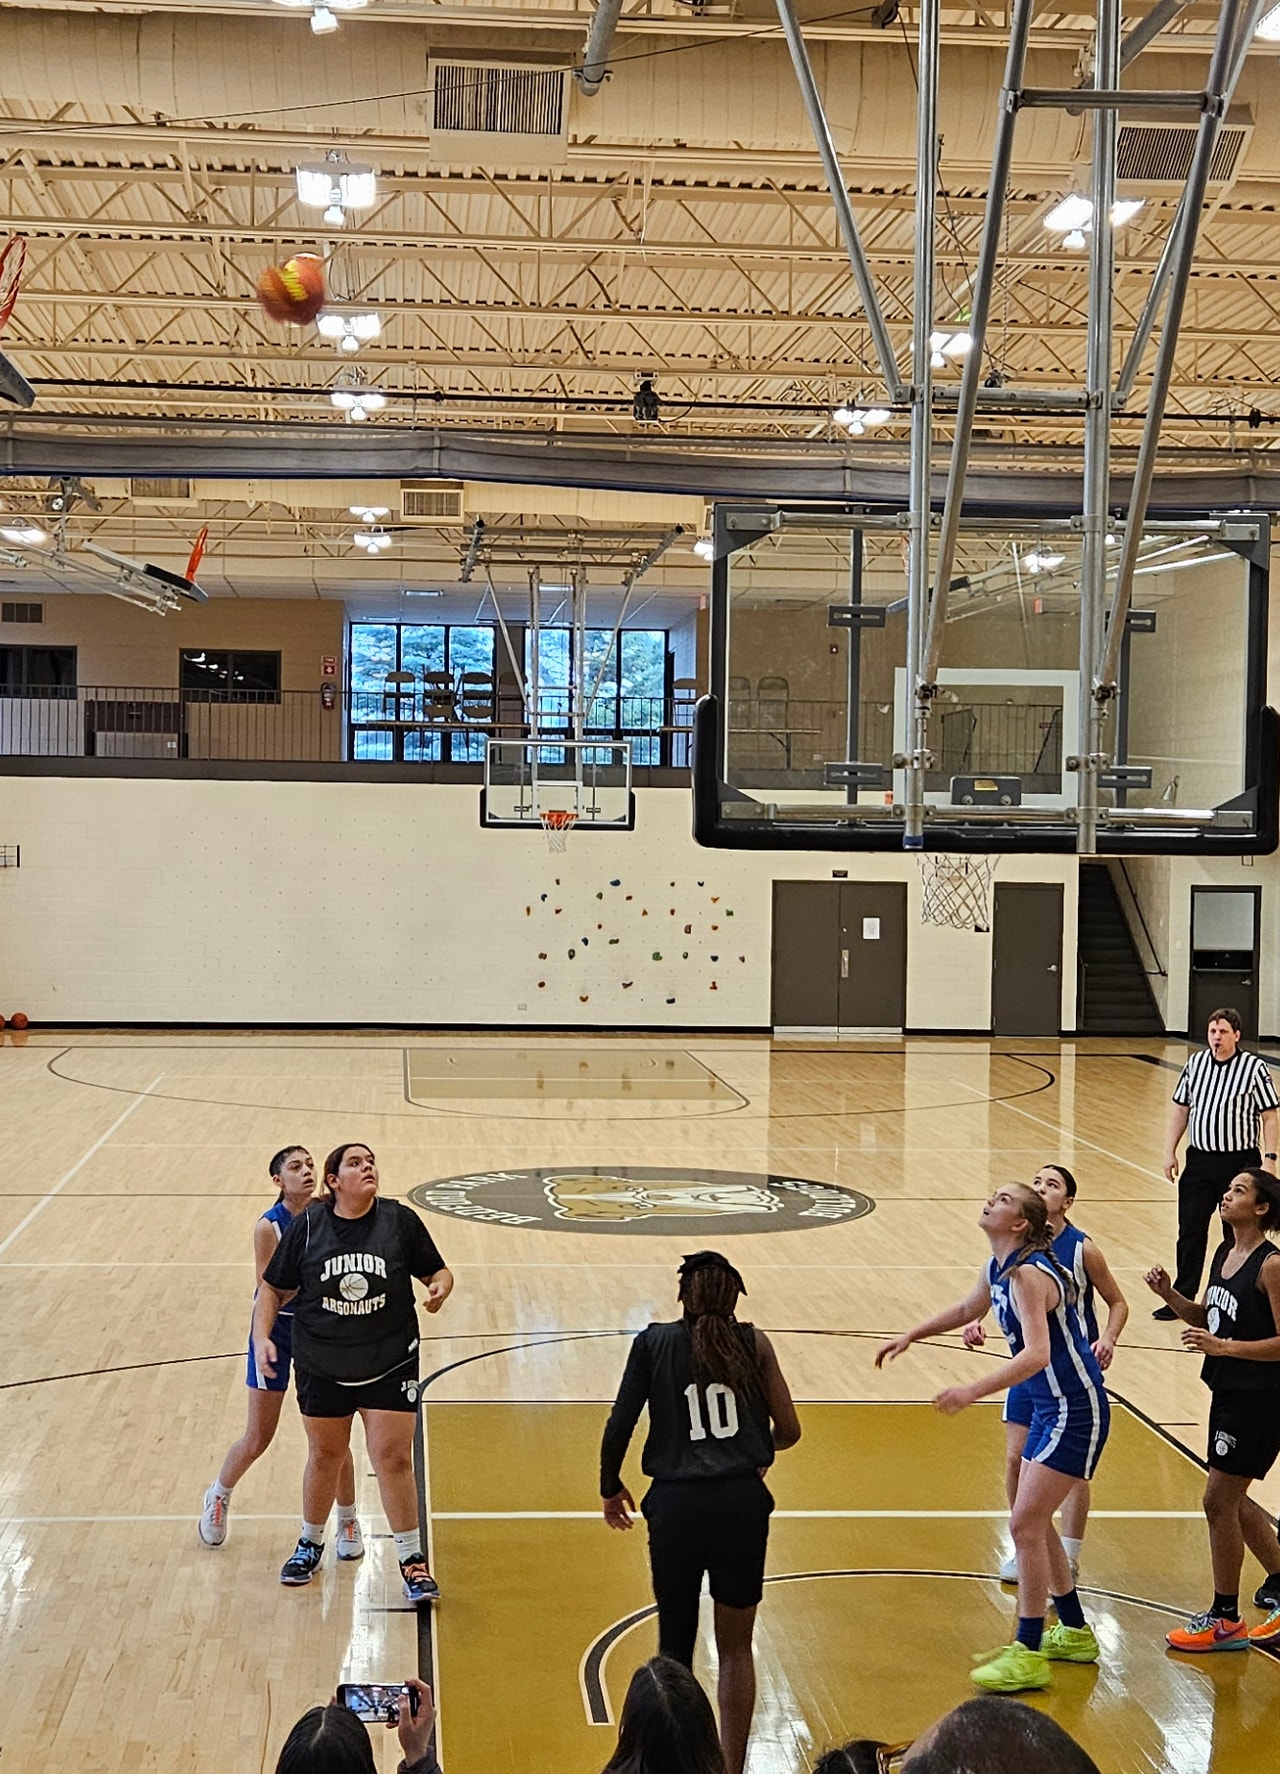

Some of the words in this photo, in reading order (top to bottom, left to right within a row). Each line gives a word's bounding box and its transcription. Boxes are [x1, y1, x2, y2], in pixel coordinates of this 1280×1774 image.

[435, 1172, 528, 1190] PARK
[425, 1190, 543, 1224] BEDFORD
[769, 1181, 856, 1219] BULLDOGS
[320, 1253, 387, 1282] JUNIOR
[322, 1293, 386, 1316] ARGONAUTS
[684, 1382, 739, 1441] 10
